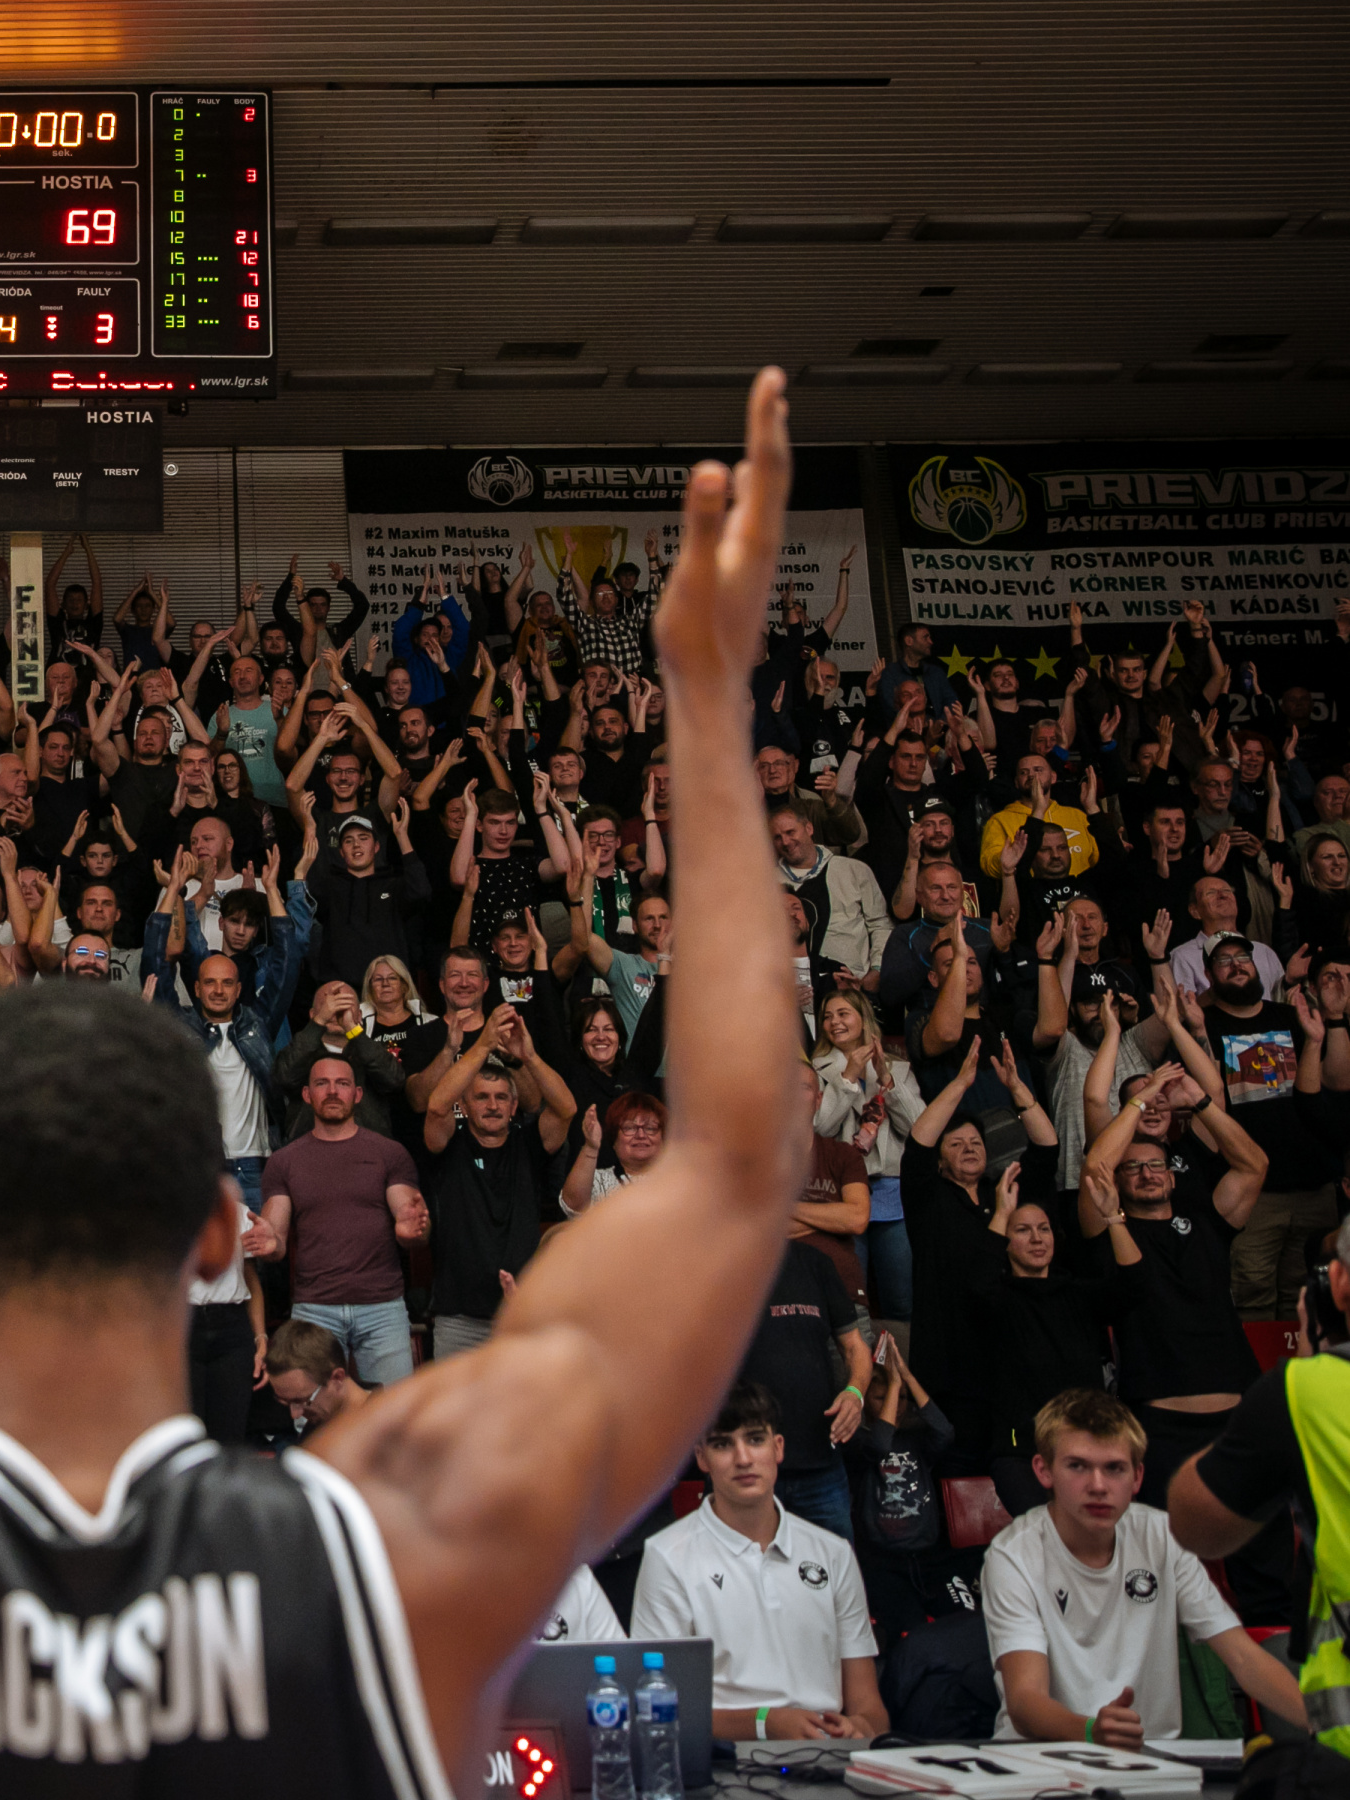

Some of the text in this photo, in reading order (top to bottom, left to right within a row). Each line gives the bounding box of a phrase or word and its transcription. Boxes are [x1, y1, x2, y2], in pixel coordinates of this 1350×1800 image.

[173, 106, 256, 122] 0 2
[173, 128, 184, 141] 2
[51, 149, 73, 158] sek.
[175, 148, 184, 161] 3
[175, 167, 257, 183] 7 3
[41, 175, 114, 190] HOSTIA
[174, 190, 184, 203] 8
[170, 210, 185, 223] 10
[65, 209, 117, 245] 69
[170, 229, 258, 245] 12 21
[170, 250, 259, 265] 15 12
[170, 272, 259, 287] 17 7
[76, 287, 112, 297] FAULY
[164, 293, 260, 308] 21 18
[95, 313, 114, 344] 3
[165, 314, 260, 329] 33 6
[200, 375, 269, 388] www.lgr.sk
[86, 411, 154, 424] HOSTIA
[0, 456, 36, 464] electronic
[52, 472, 82, 480] FAULY
[103, 468, 140, 476] TRESTY
[55, 480, 79, 488] (SETY)
[543, 489, 630, 500] BASKETBALL
[633, 489, 668, 500] CLUB
[1046, 513, 1201, 534] BASKETBALL
[1205, 512, 1267, 531] CLUB
[365, 526, 510, 540] #2 Maxim Matuška
[366, 546, 385, 558] #4
[389, 545, 437, 558] Jakub
[911, 552, 1036, 573] PASOVSKÝ
[1050, 551, 1215, 571] ROSTAMPOUR
[1227, 545, 1306, 567] MARIĆ
[368, 564, 386, 577] #5
[369, 583, 398, 596] #10
[911, 569, 1349, 597] STANOJEVIĆ KÖRNER STAMENKOVIĆ
[371, 602, 399, 615] #12
[916, 602, 1014, 621] HULJAK
[1230, 594, 1320, 616] KÁDAŠI
[14, 585, 40, 697] FANS
[1219, 629, 1331, 647] Tréner: M.
